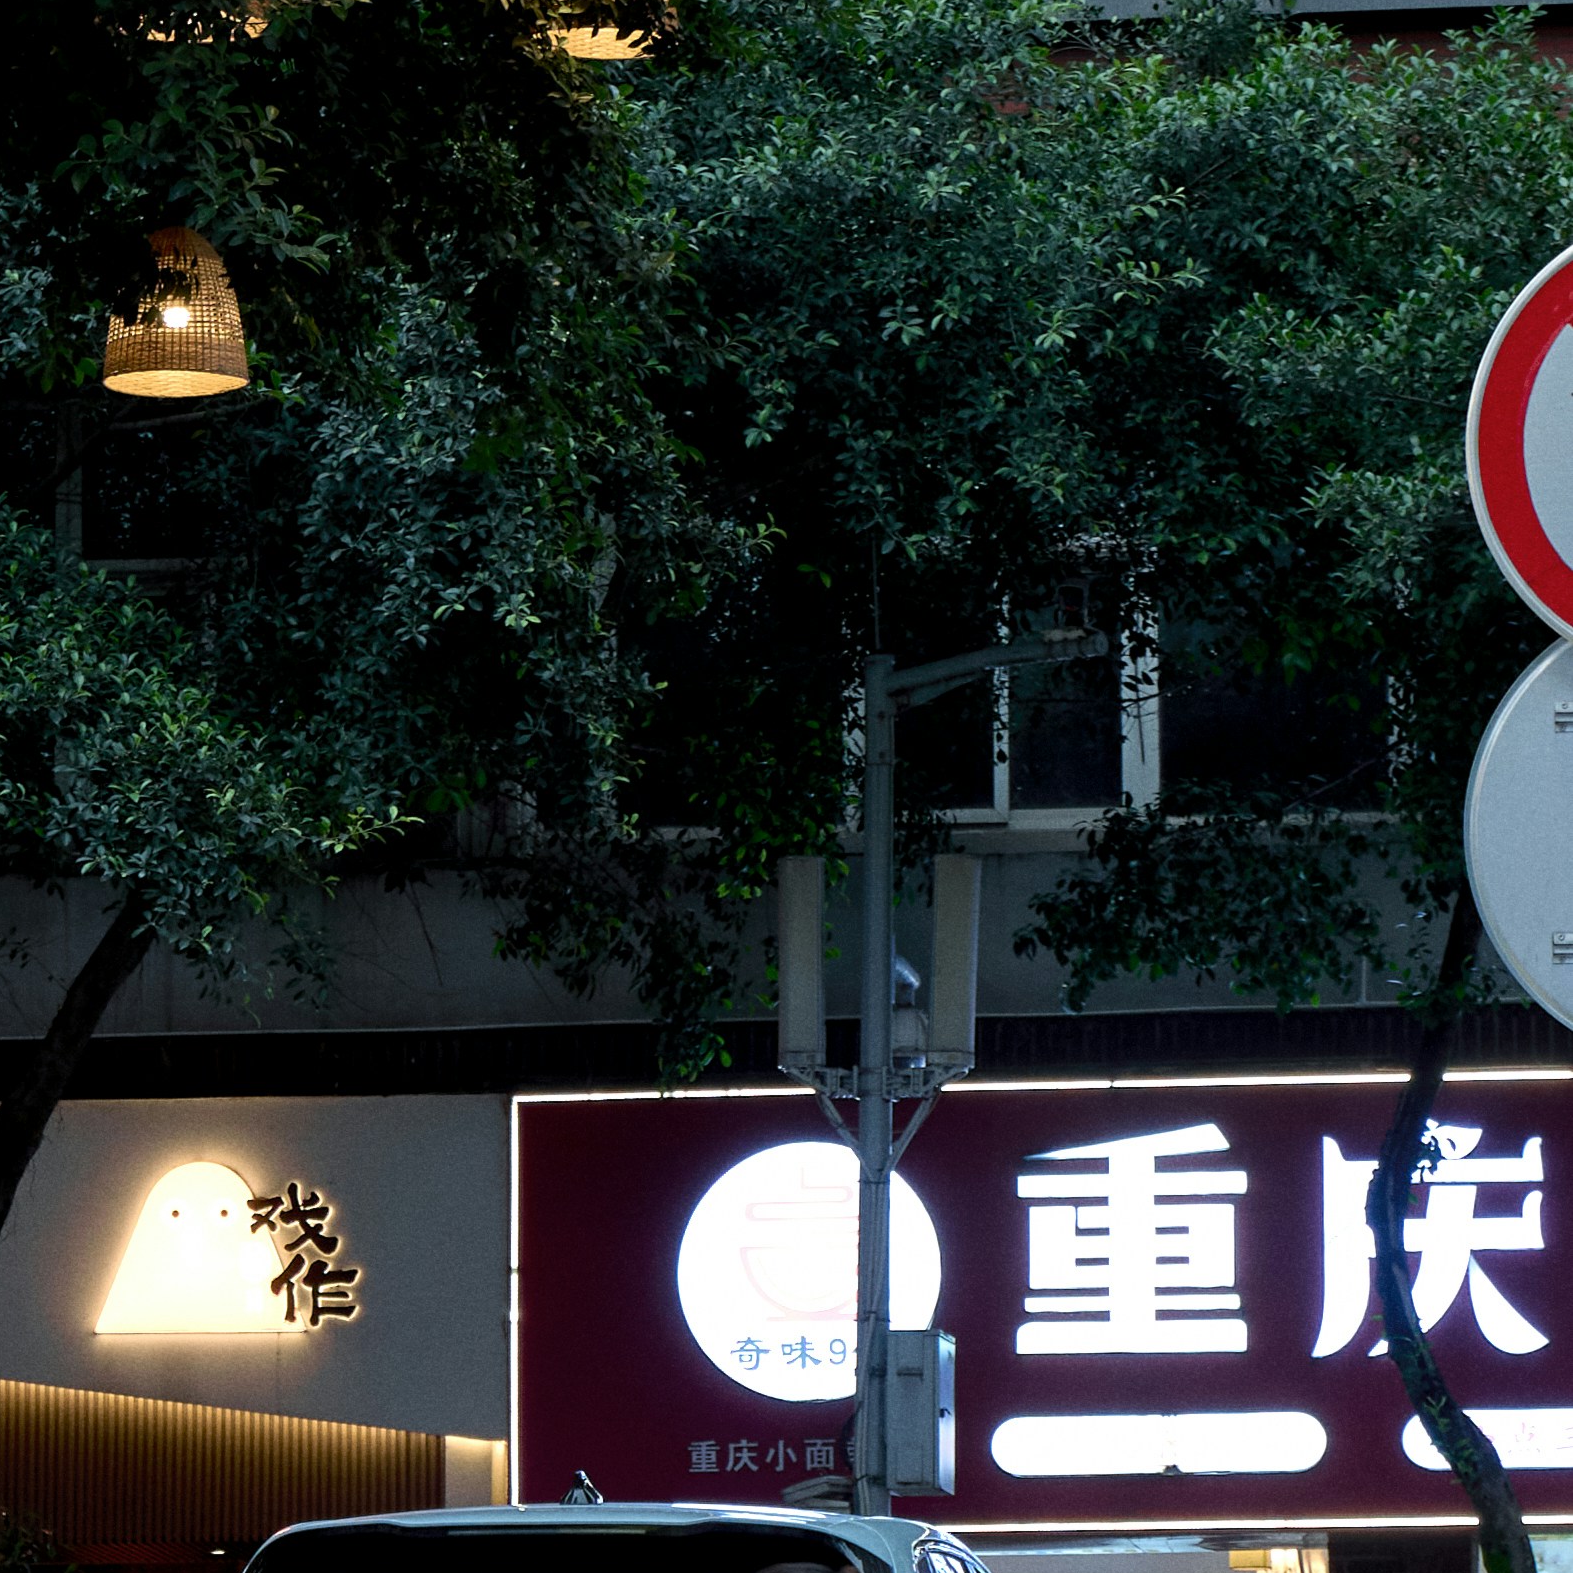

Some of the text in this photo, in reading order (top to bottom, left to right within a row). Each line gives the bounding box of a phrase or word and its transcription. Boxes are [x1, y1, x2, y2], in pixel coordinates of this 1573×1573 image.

[1015, 1119, 1551, 1359] 重庆
[730, 1334, 857, 1370] 奇味9
[687, 1437, 856, 1474] 重庆小面
